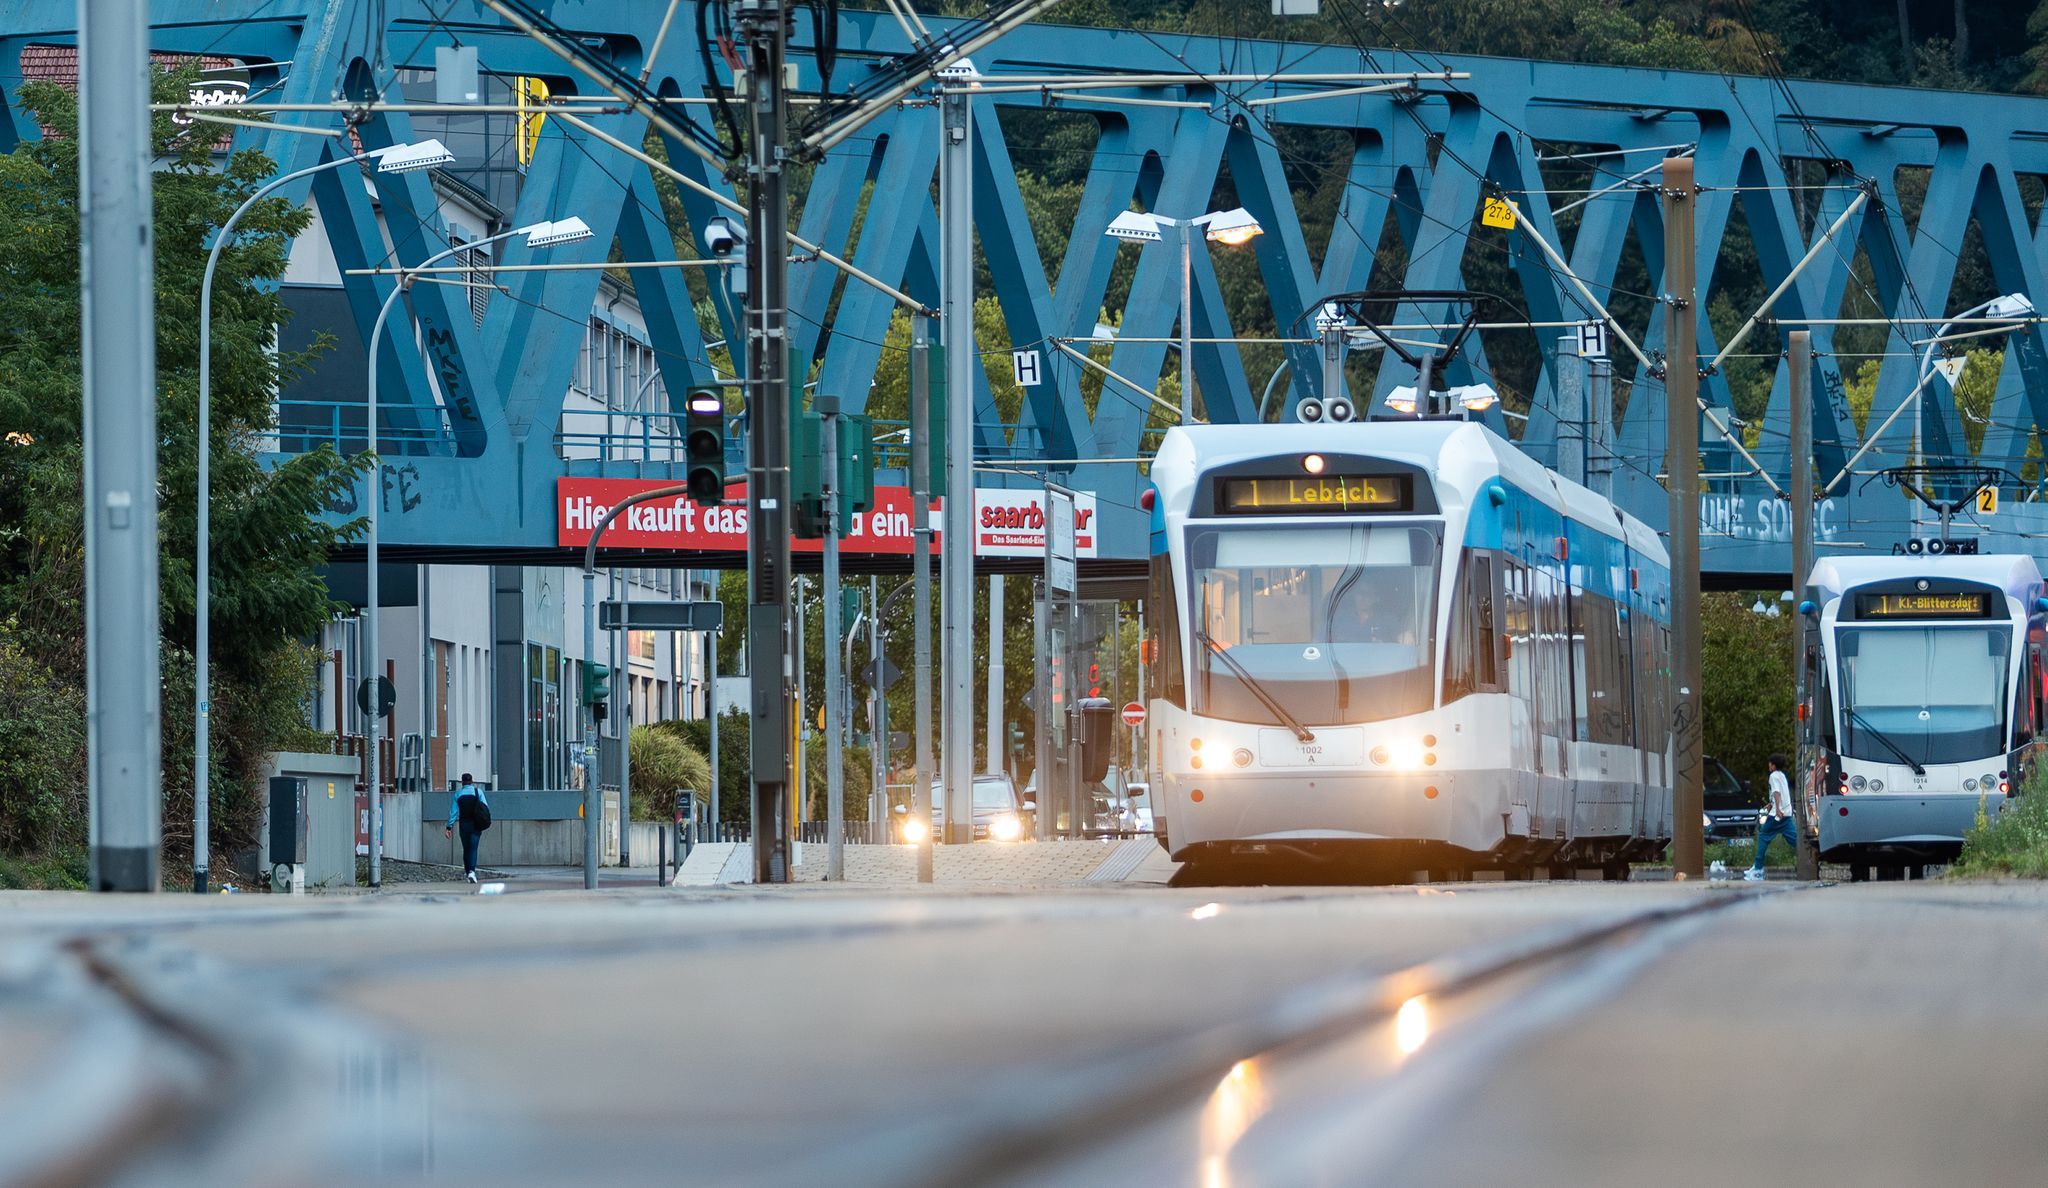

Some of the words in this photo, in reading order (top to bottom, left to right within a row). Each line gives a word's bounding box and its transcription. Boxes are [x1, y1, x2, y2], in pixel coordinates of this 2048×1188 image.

[1489, 205, 1512, 221] 27,8
[1582, 323, 1602, 352] H
[1017, 354, 1037, 382] H
[1947, 363, 1954, 376] 2
[1250, 480, 1258, 506] 1
[1289, 478, 1377, 503] Lebach
[1982, 490, 1993, 512] 2
[627, 496, 696, 532] kauft
[703, 505, 748, 534] das
[1880, 595, 1888, 614] 1
[1302, 746, 1322, 754] 1002
[1308, 755, 1315, 763] A
